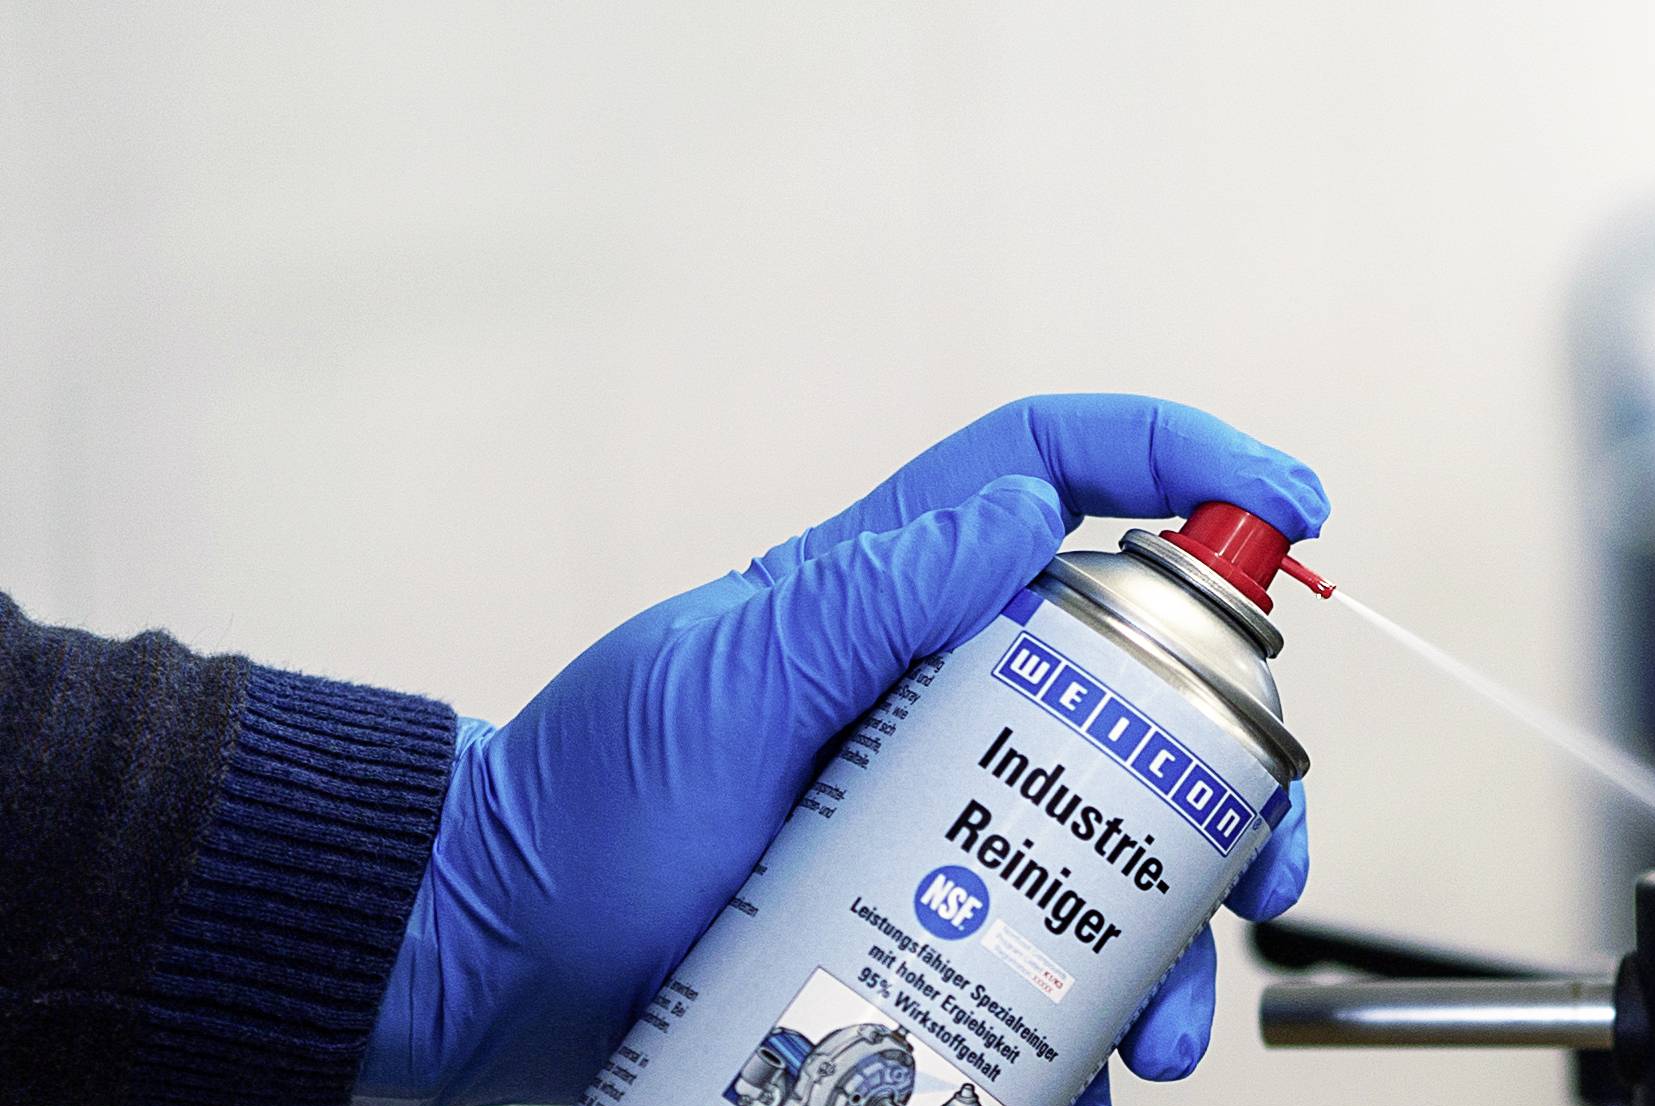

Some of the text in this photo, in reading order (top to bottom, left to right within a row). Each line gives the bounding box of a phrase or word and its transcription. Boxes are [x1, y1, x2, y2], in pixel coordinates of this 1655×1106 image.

[945, 800, 1121, 954] Reiniger
[978, 727, 1169, 894] Industrie-
[921, 875, 982, 926] NSF
[850, 897, 970, 989] Leistungsfähiger
[971, 985, 1058, 1062] Spezialreiniger
[858, 967, 1001, 1082] 95% Wirkstoffgehalt
[869, 946, 1020, 1064] mit hoher Ergiebigkeit
